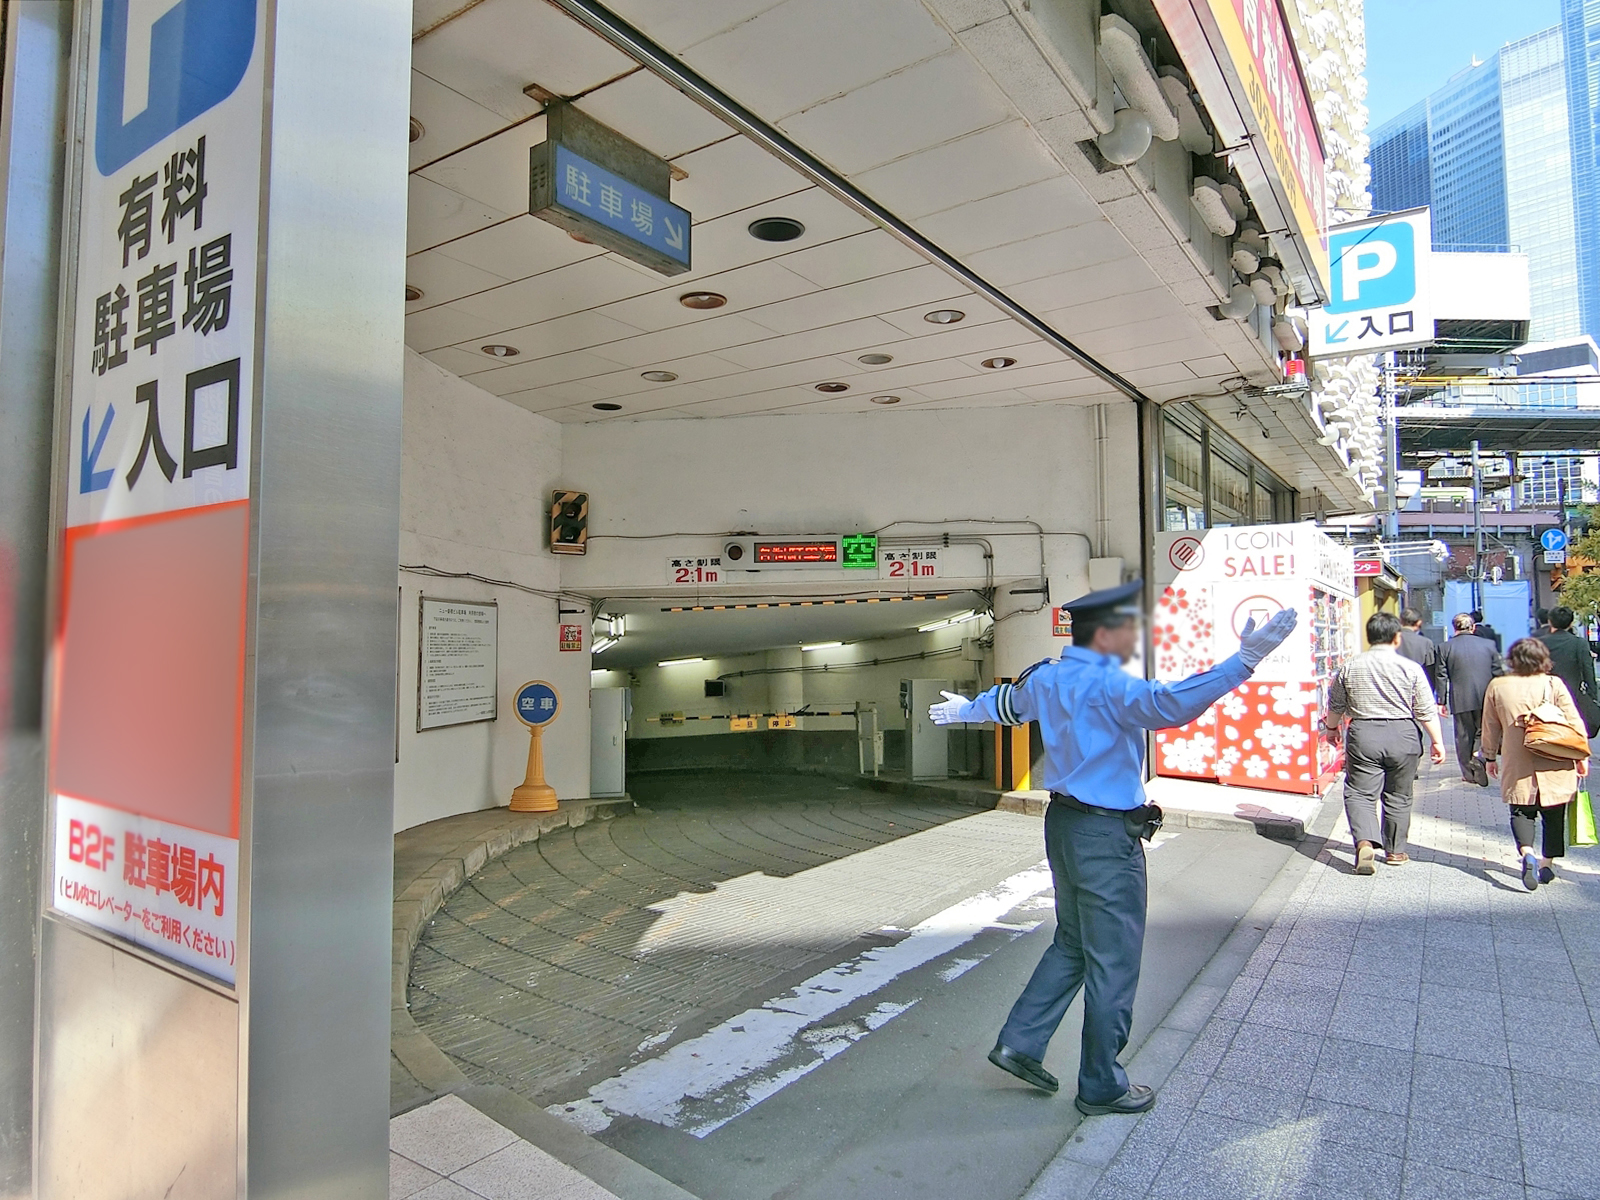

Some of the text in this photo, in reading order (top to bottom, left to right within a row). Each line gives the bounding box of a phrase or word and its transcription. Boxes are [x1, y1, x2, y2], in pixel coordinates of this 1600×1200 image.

[117, 134, 208, 269] 有料
[566, 163, 654, 236] 駐車場
[1341, 240, 1397, 302] P
[91, 233, 234, 376] 駐車場
[1357, 310, 1414, 340] 入口
[125, 357, 241, 492] 入口
[671, 558, 721, 567] 高さ制限
[842, 533, 877, 568] 空
[884, 551, 937, 561] 高さ制限
[1224, 554, 1295, 578] SALE!
[521, 697, 554, 711] 空車
[772, 719, 791, 728] 停止
[69, 818, 225, 918] B2F 駐車場内
